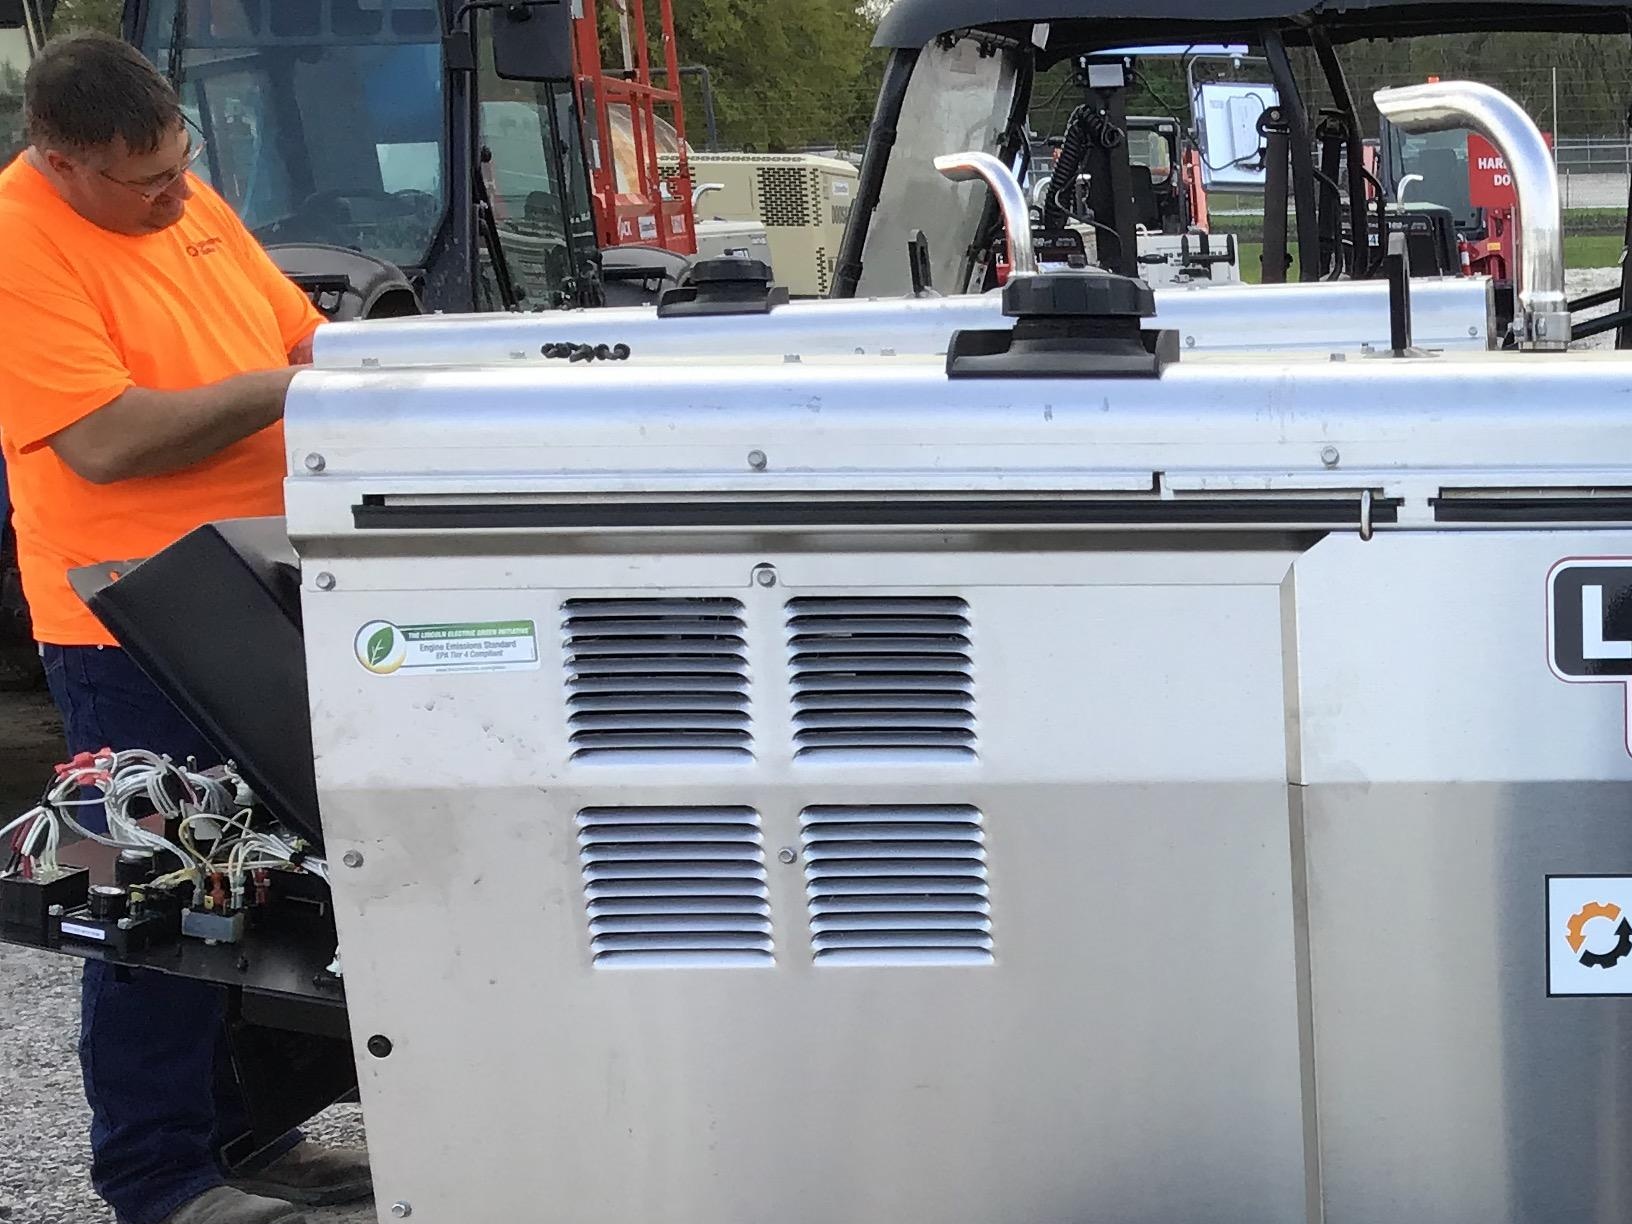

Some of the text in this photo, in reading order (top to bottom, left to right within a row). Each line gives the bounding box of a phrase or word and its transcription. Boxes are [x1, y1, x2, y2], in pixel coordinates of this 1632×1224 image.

[420, 640, 516, 652] Engine Emissions Standard
[470, 650, 503, 659] Compliant
